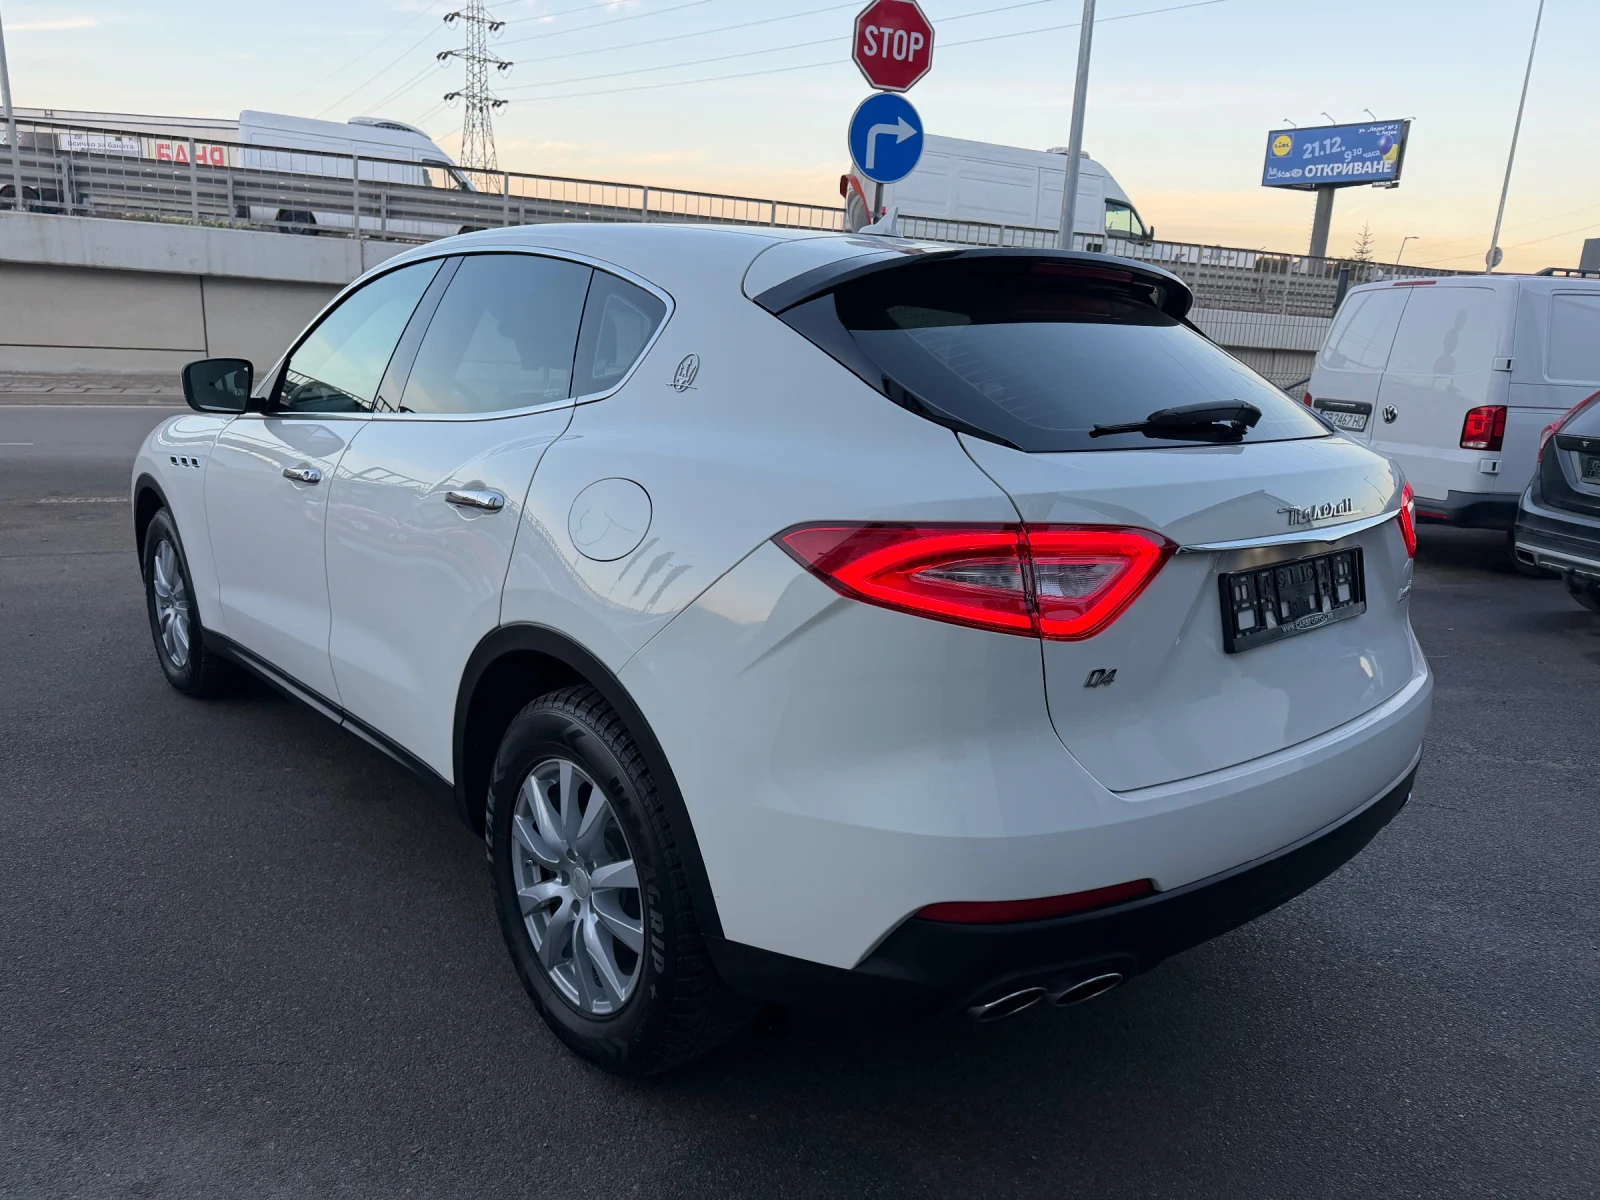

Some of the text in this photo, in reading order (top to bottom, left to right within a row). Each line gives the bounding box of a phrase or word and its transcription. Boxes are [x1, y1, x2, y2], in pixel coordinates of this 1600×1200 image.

[863, 24, 924, 62] STOP
[1302, 136, 1346, 160] 21.12.
[1362, 150, 1381, 158] часа
[1304, 160, 1392, 178] ОТКРИВАНЕ
[1332, 413, 1353, 426] 2467
[1083, 666, 1118, 688] Q4
